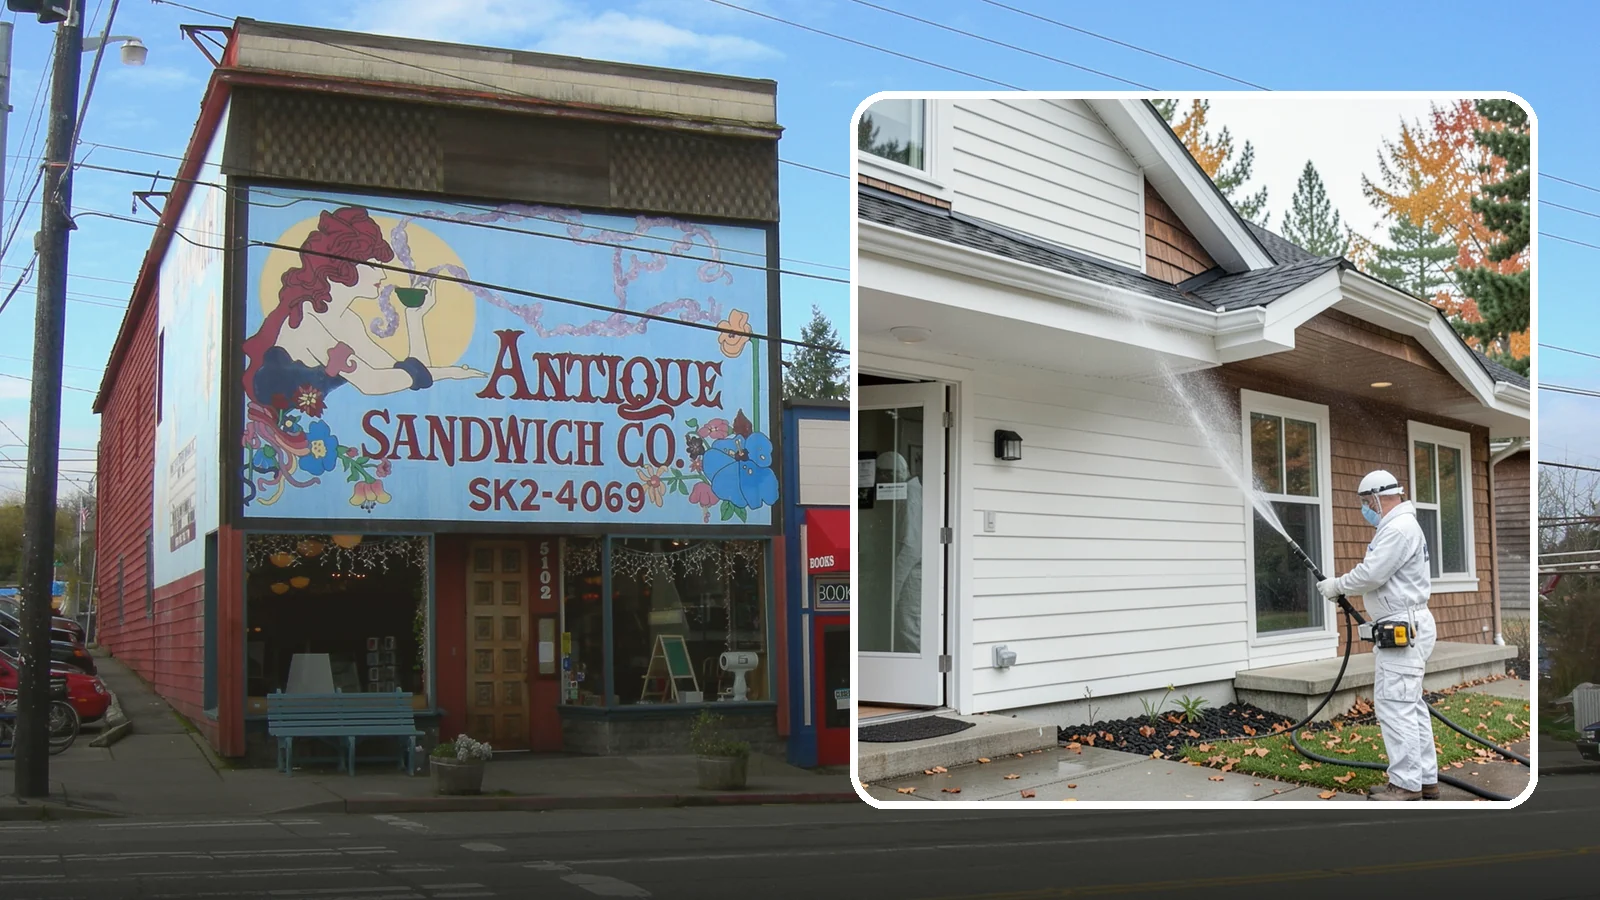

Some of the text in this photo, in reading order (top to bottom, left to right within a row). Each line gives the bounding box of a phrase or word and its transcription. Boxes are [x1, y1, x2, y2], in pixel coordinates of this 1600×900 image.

[476, 329, 724, 421] ANTIQUE
[361, 409, 685, 469] SANDWICH CO.
[468, 477, 645, 513] SK2-4069
[539, 541, 552, 600] 5102
[809, 555, 835, 569] BOOKS
